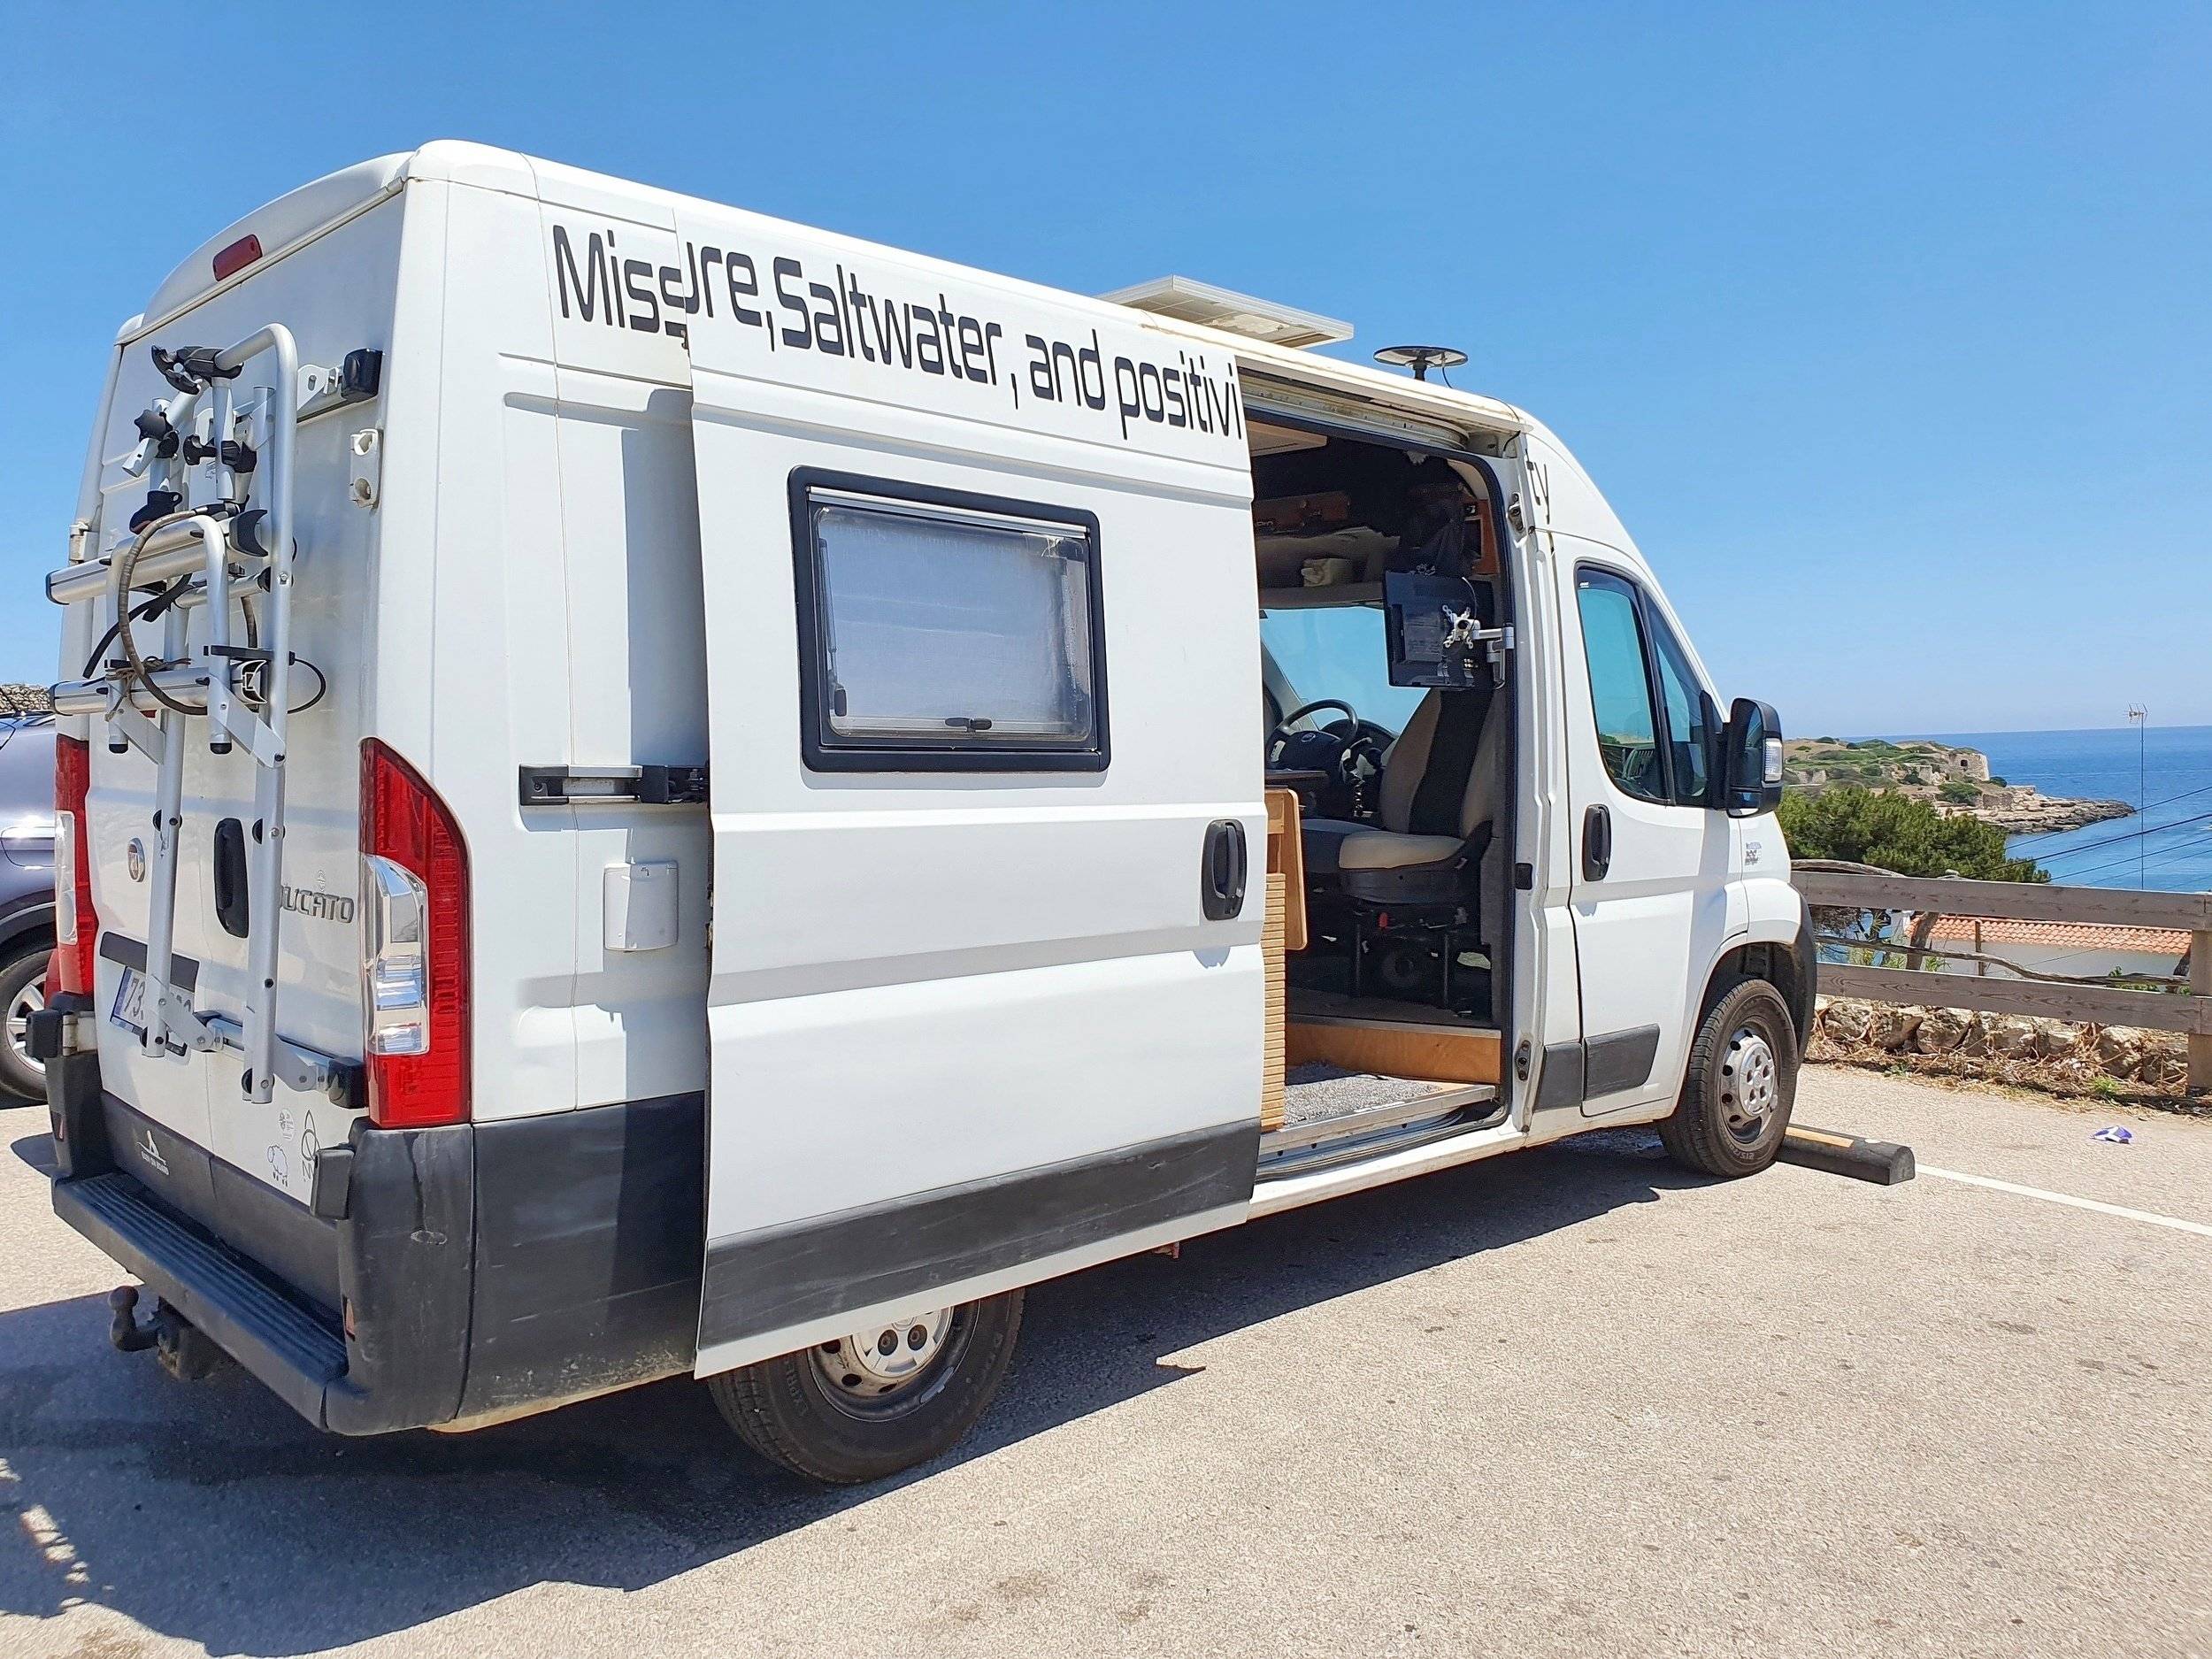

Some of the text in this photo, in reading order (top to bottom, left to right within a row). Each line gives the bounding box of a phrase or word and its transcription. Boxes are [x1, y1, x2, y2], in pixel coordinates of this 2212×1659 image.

[1025, 328, 1106, 411] and
[1115, 349, 1241, 441] positivi
[279, 885, 354, 923] UCATO
